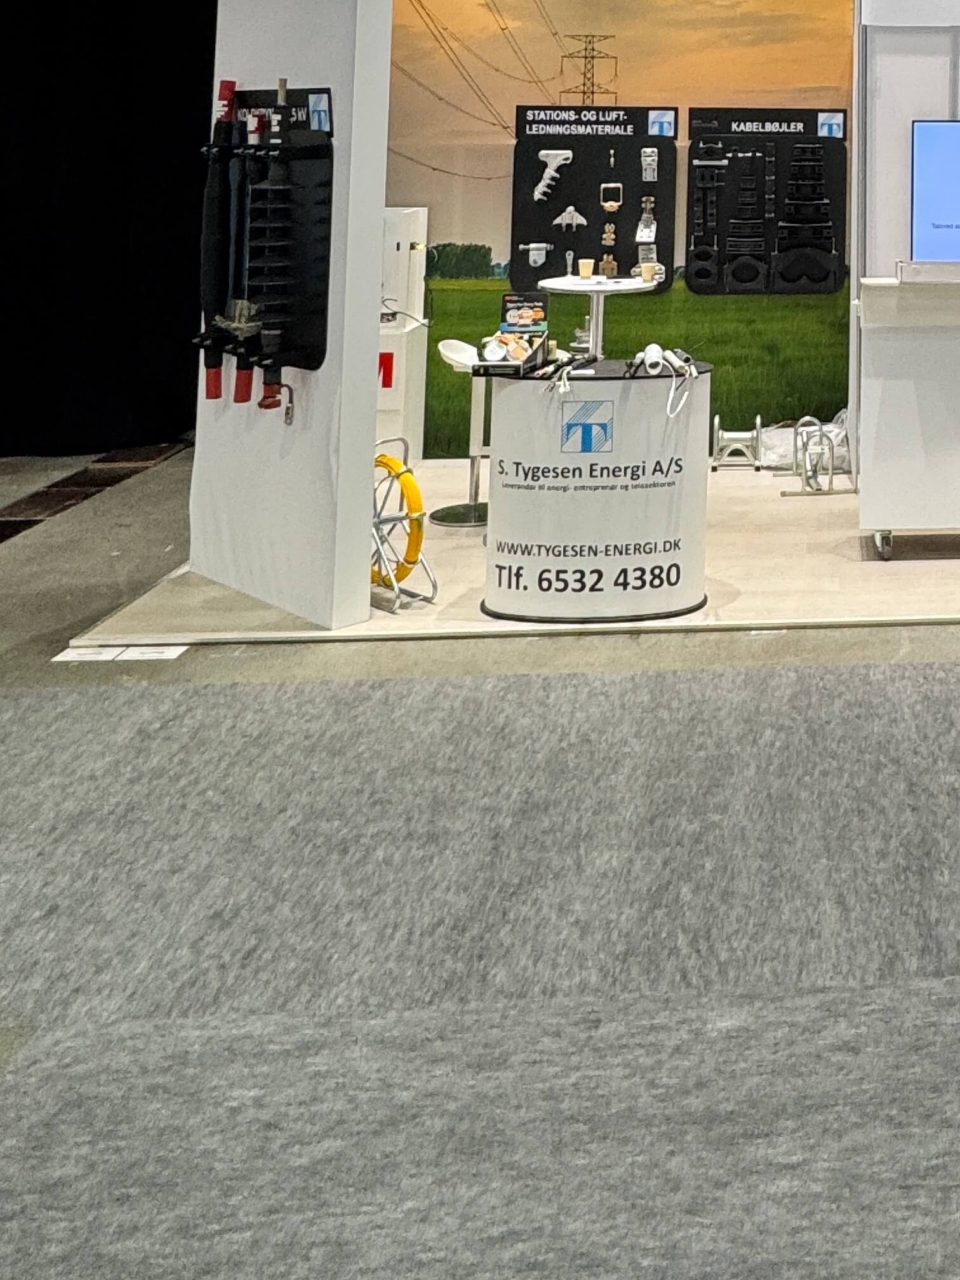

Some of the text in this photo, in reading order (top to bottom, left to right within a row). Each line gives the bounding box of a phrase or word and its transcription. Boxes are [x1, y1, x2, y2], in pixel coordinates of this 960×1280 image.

[526, 110, 627, 121] STATIONS- OG LUFT-
[526, 124, 634, 135] LEDNINGSMATERIALE
[731, 121, 804, 133] KABELBØJLER
[498, 457, 683, 482] S. Tygesen Energi A/S
[495, 538, 681, 558] WWW.TYGESEN-ENERGI.DK
[495, 563, 681, 593] Tlf. 6532 4380
